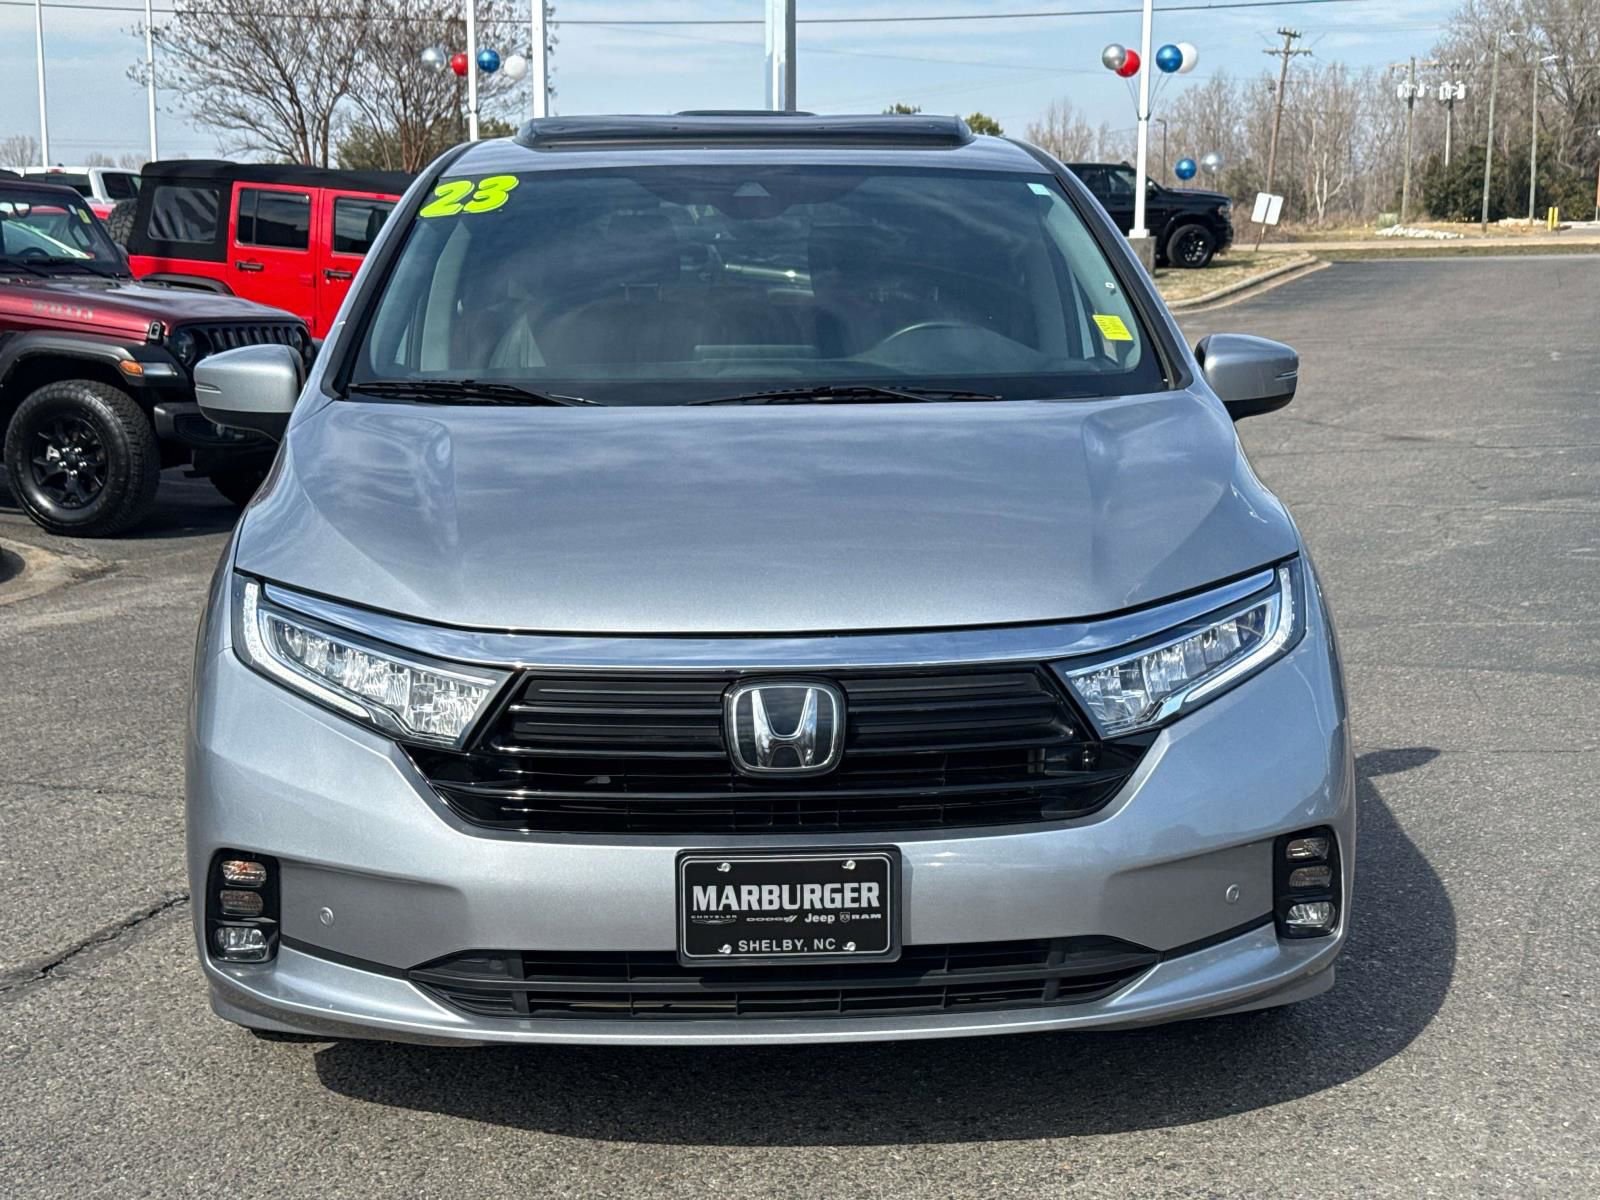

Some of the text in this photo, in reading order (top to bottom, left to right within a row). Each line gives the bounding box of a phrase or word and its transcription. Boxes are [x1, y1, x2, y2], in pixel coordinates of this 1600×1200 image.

[420, 175, 519, 217] 23
[693, 882, 880, 911] MARBURGER
[804, 913, 836, 924] Jeep
[738, 938, 836, 952] SHELBY, NC
